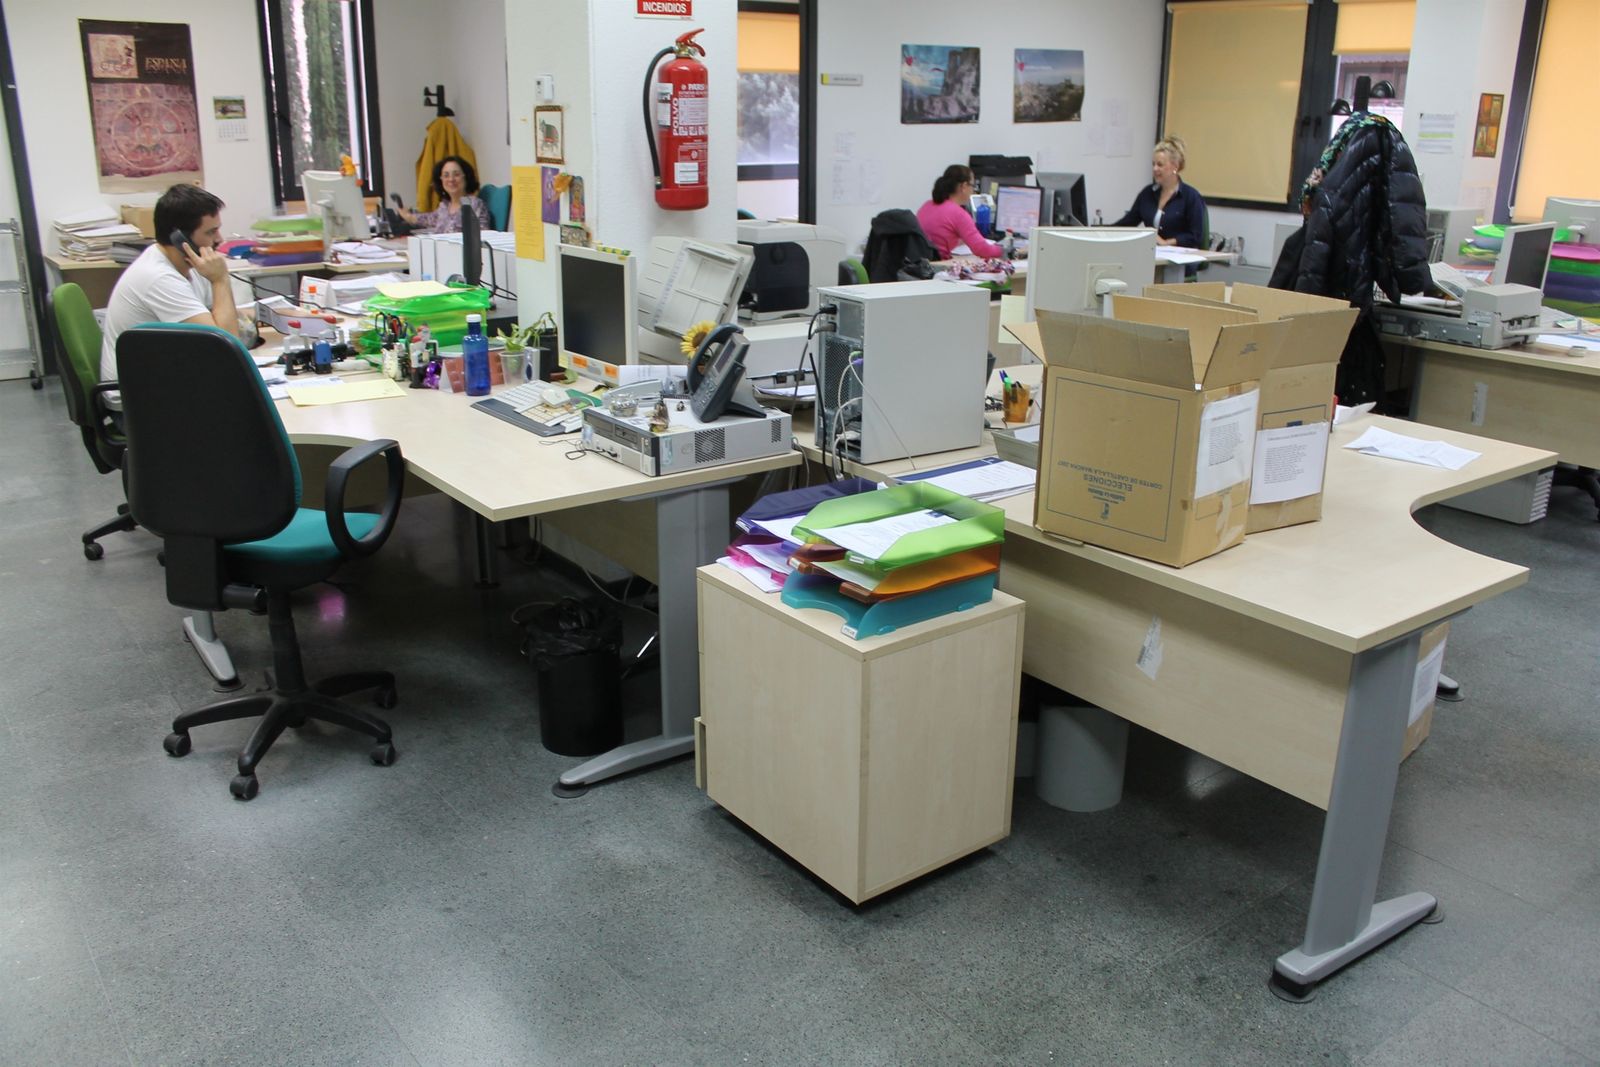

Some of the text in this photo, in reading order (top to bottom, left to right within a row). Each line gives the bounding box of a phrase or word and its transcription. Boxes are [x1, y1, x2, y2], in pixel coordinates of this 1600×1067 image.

[642, 2, 687, 14] INCENDIOS
[672, 97, 680, 136] POLVO
[1083, 474, 1133, 492] ELECCIONES
[1139, 479, 1163, 489] CORTES
